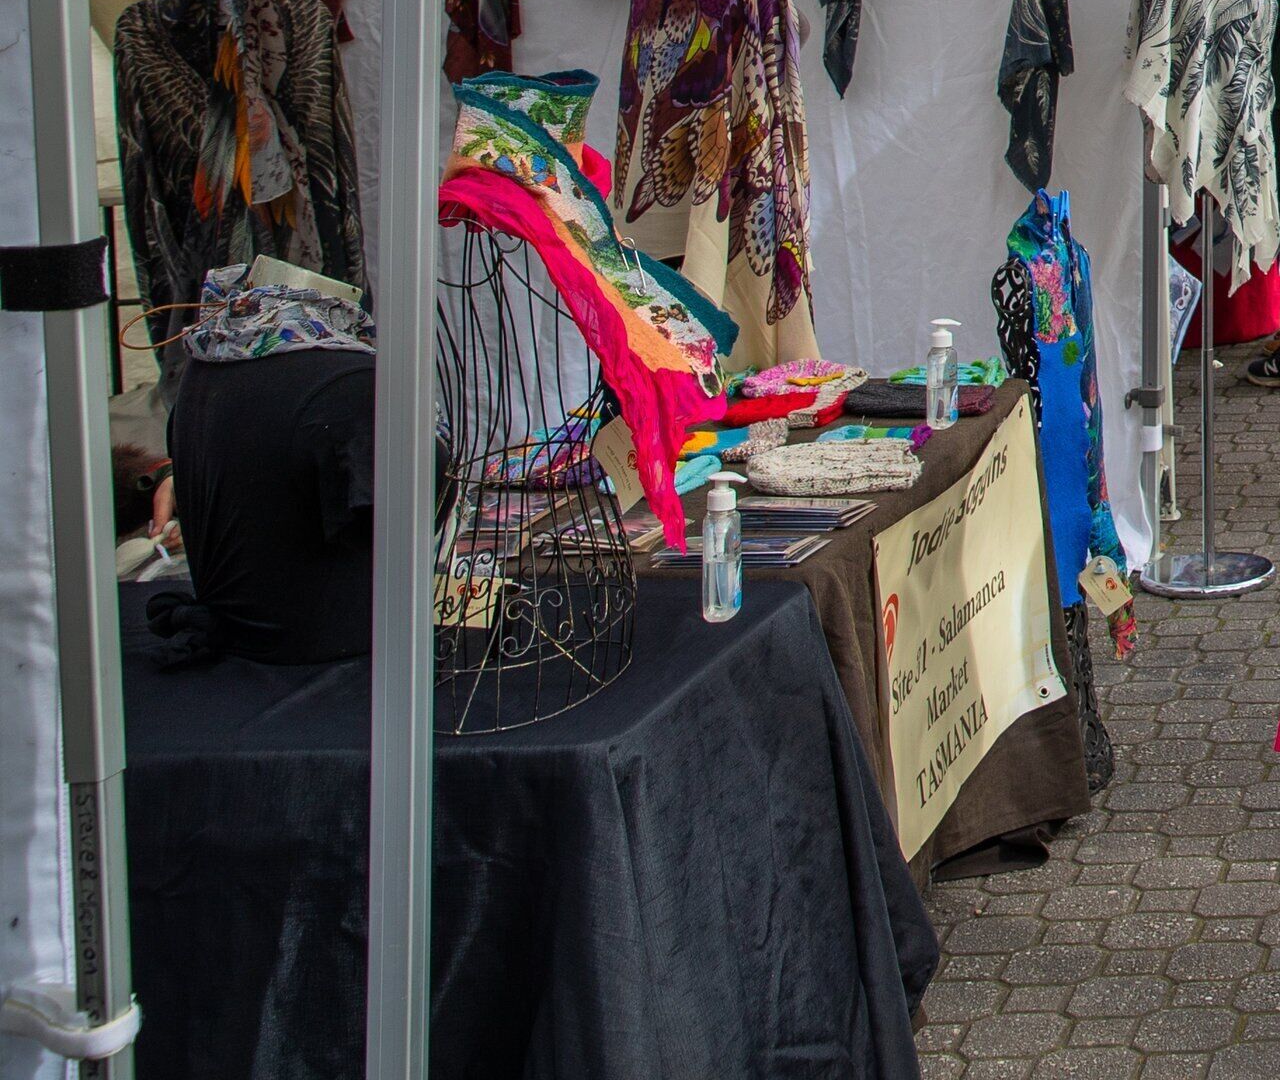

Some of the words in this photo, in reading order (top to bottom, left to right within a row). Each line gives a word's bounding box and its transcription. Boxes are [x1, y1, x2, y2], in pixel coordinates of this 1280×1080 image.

[907, 505, 956, 576] Jodie
[892, 669, 913, 715] Site
[939, 568, 1006, 654] Salamanca
[926, 656, 969, 731] Market
[916, 694, 989, 809] TASMANIA
